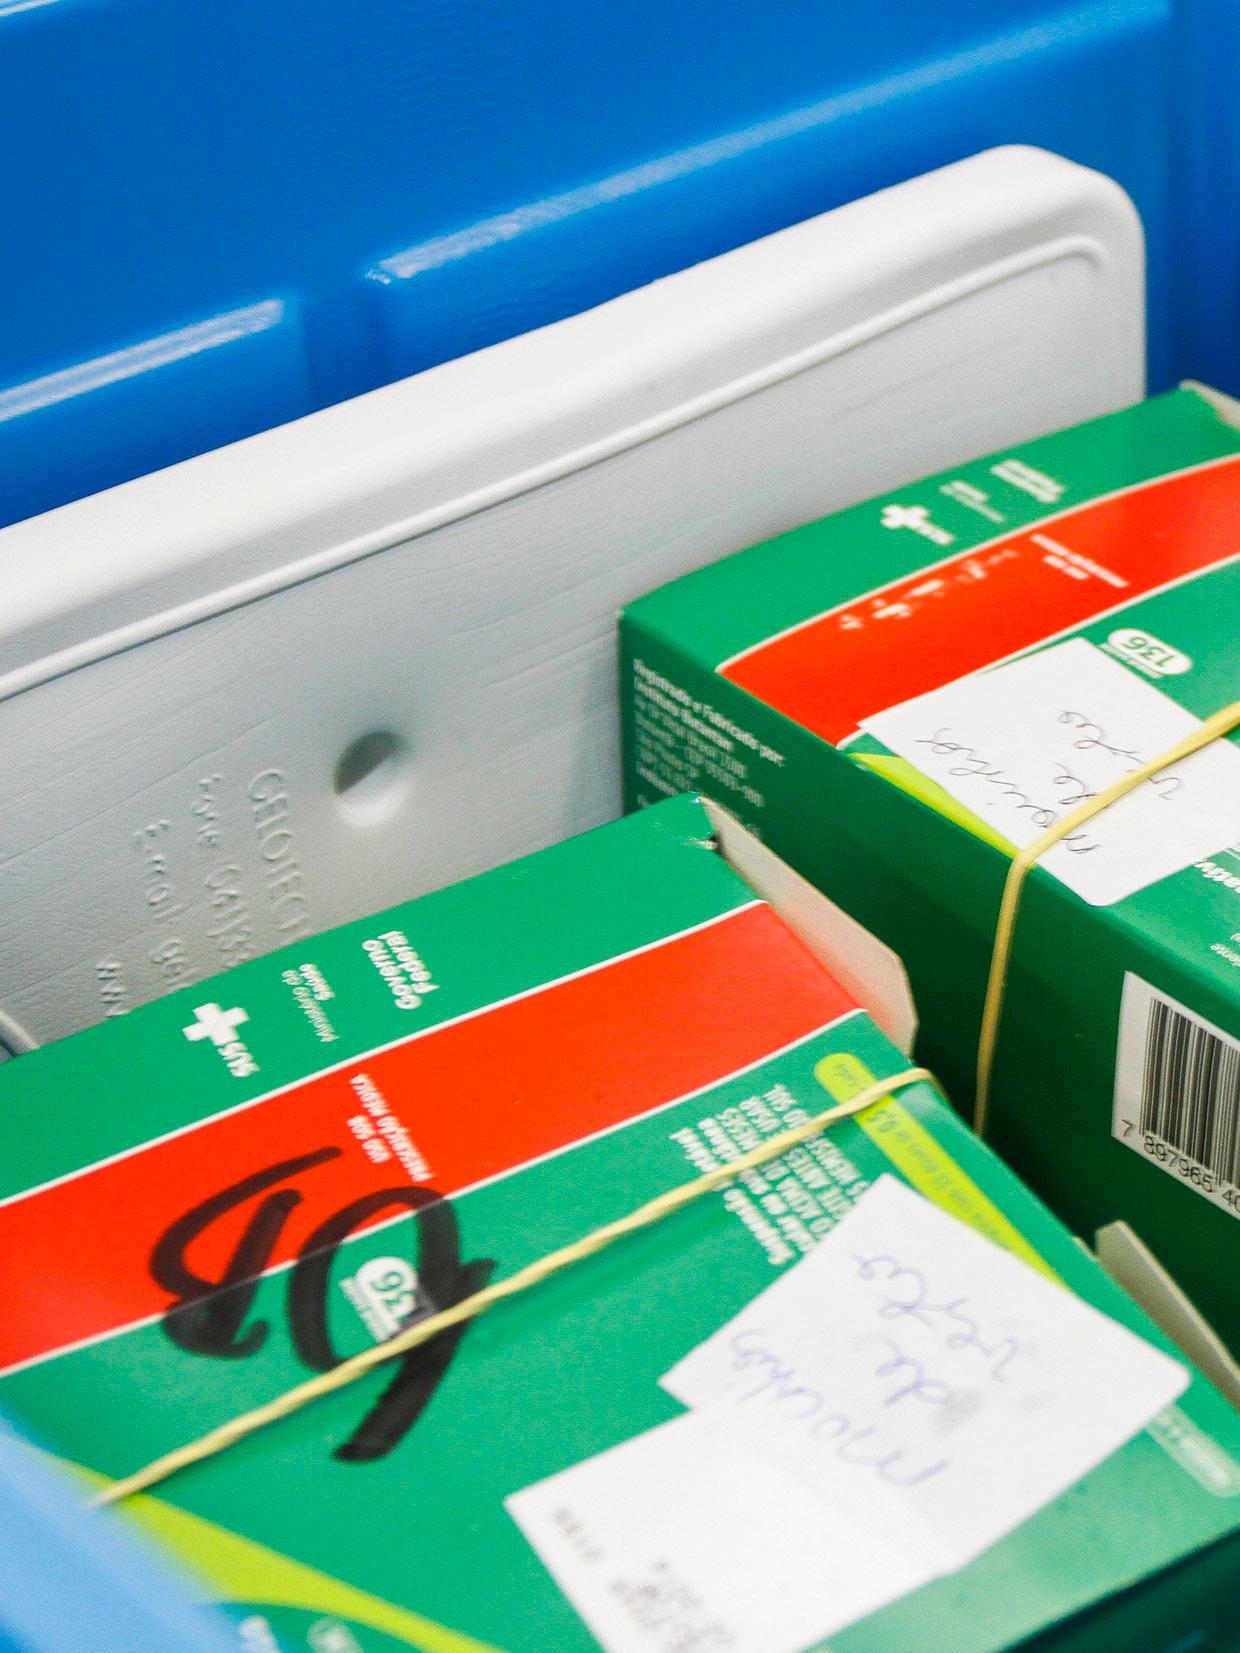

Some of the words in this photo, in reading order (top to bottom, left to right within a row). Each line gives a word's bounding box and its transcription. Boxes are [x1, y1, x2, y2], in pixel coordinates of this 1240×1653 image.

[1118, 634, 1180, 668] 136
[294, 960, 336, 1002] Saúde
[357, 937, 422, 1012] Governo
[378, 928, 438, 995] Federal
[215, 1038, 261, 1079] SUS
[344, 1071, 390, 1118] MÉDICA
[344, 1113, 377, 1140] SOB
[373, 1112, 438, 1183] PRESCRIÇÃO
[360, 1137, 393, 1164] USO
[1143, 1133, 1215, 1195] 897965
